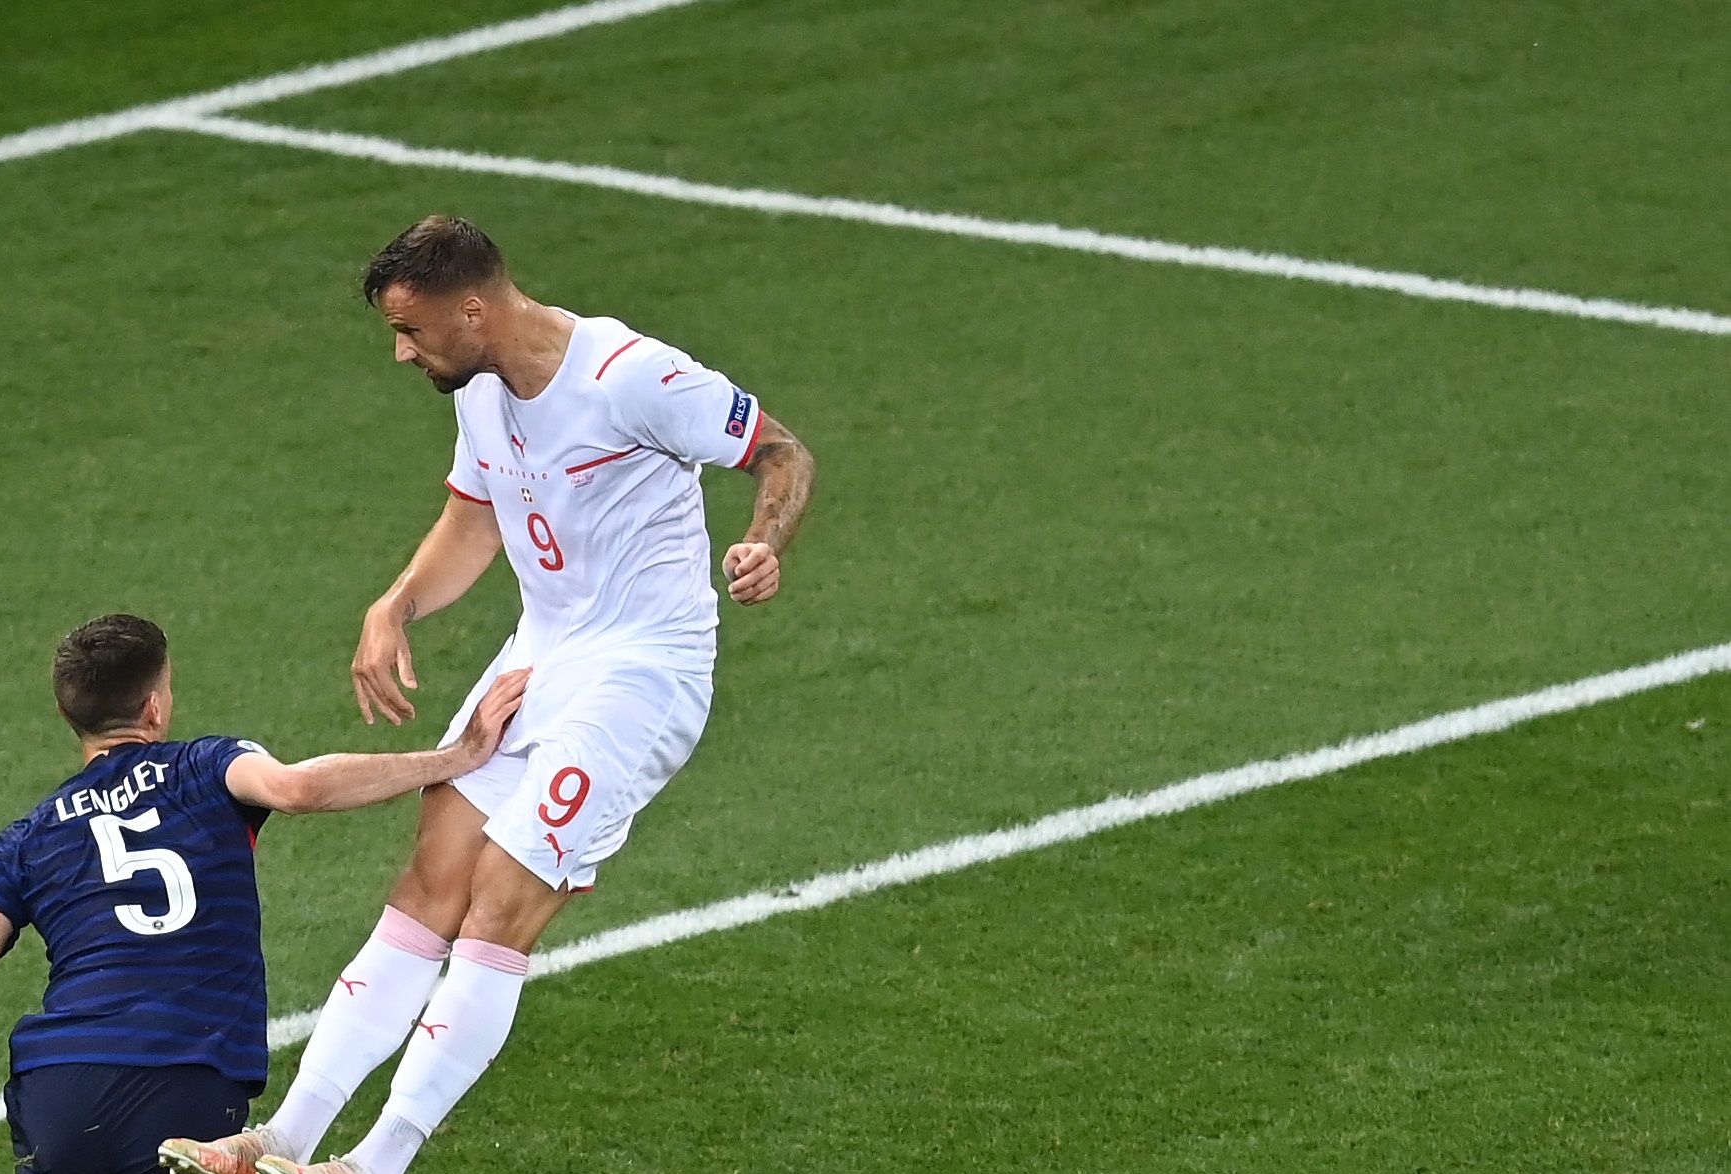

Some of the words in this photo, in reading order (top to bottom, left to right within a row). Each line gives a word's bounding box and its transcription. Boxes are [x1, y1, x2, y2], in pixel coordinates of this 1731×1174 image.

[527, 512, 564, 571] 9
[55, 760, 169, 822] LENGLET
[538, 766, 591, 828] 9
[89, 807, 197, 935] 5
